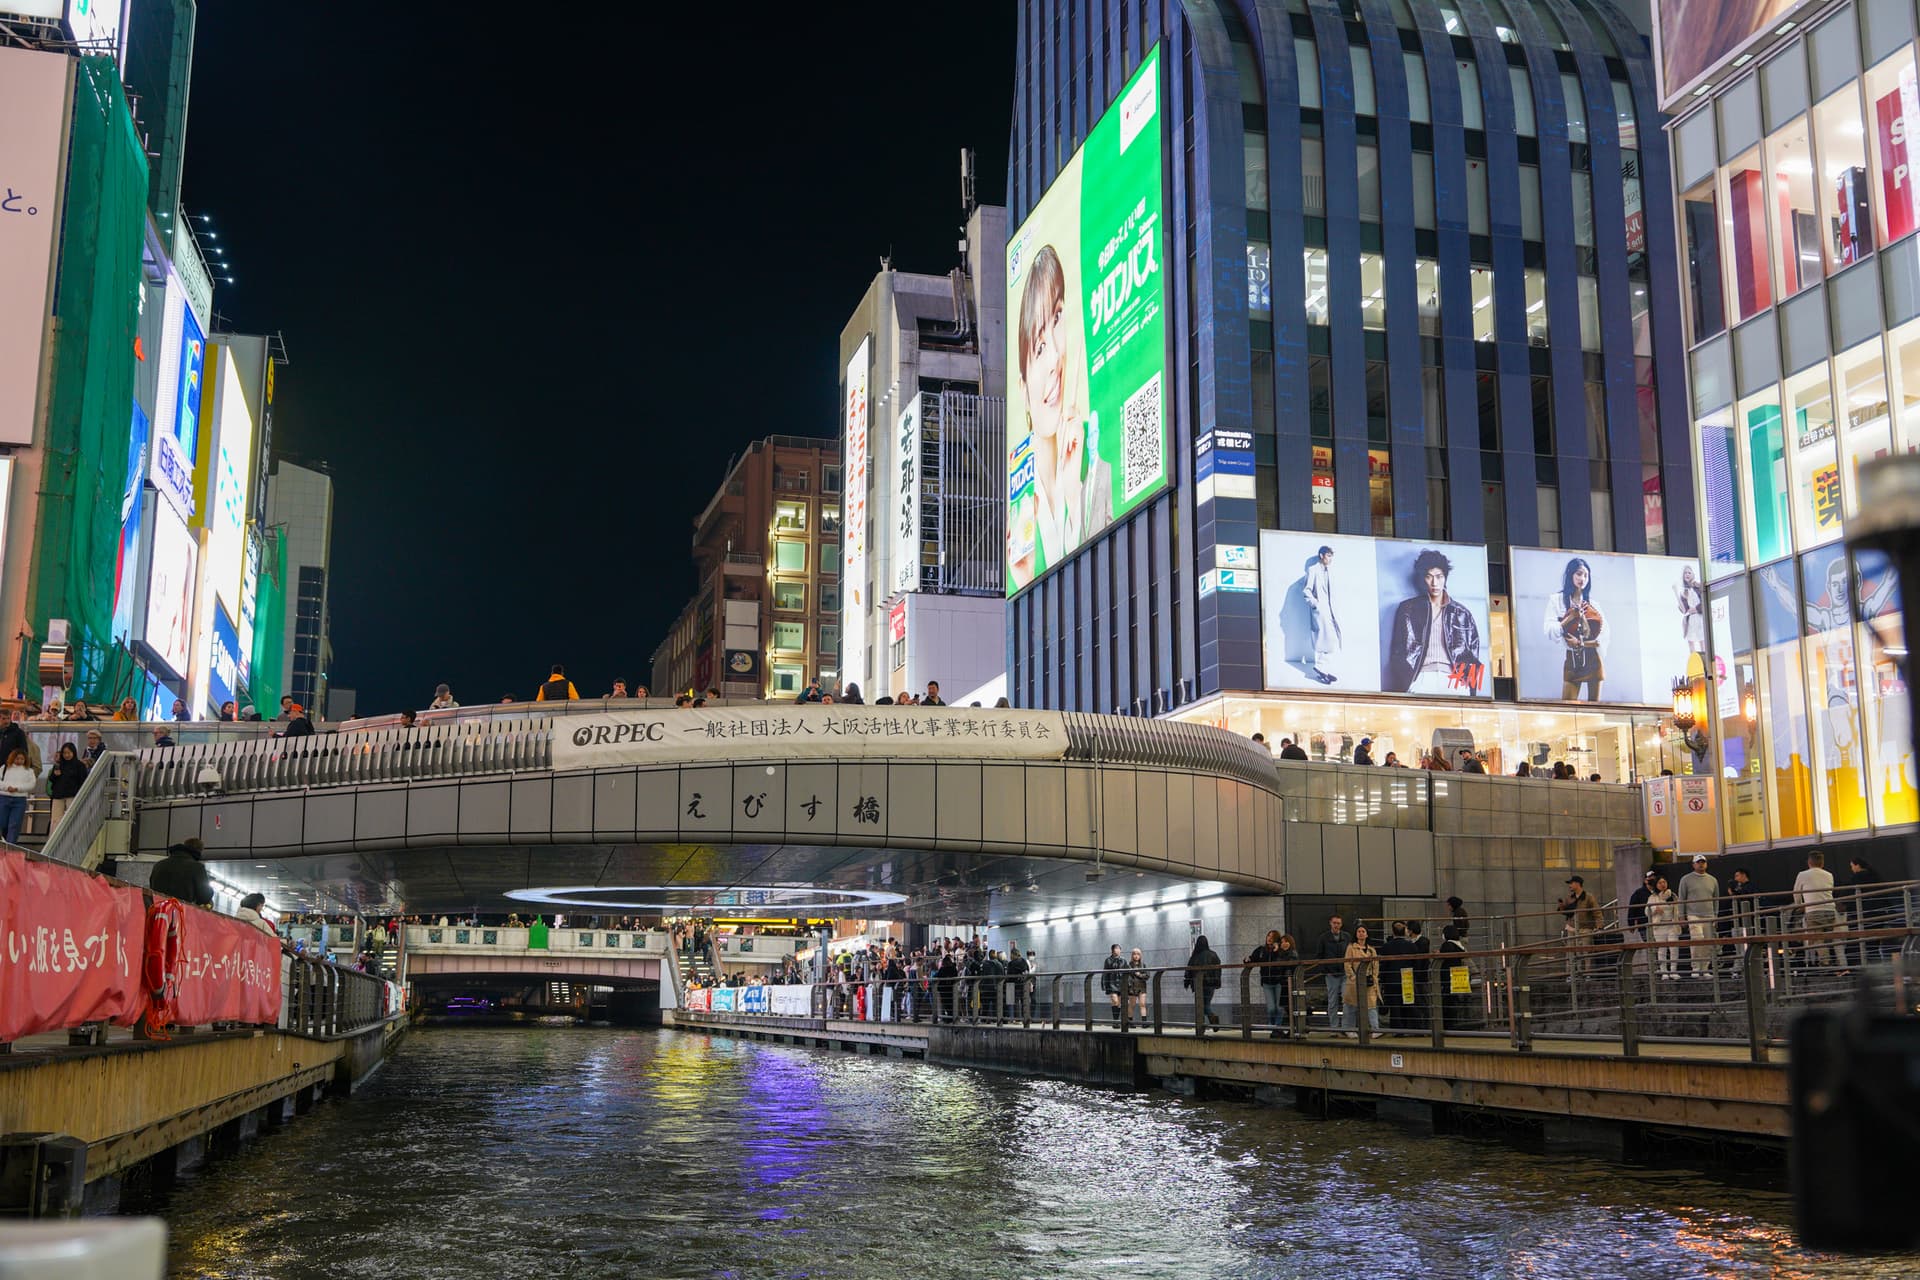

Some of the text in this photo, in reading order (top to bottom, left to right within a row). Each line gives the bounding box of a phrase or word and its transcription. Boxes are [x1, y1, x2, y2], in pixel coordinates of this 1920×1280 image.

[1090, 226, 1159, 336] サロンパス
[856, 399, 866, 530] カラオケ
[1447, 661, 1486, 692] H&M
[572, 716, 1052, 747] ORPEC 一般社団法人 大阪活性化事業実行委員会
[686, 792, 881, 825] えびす橋
